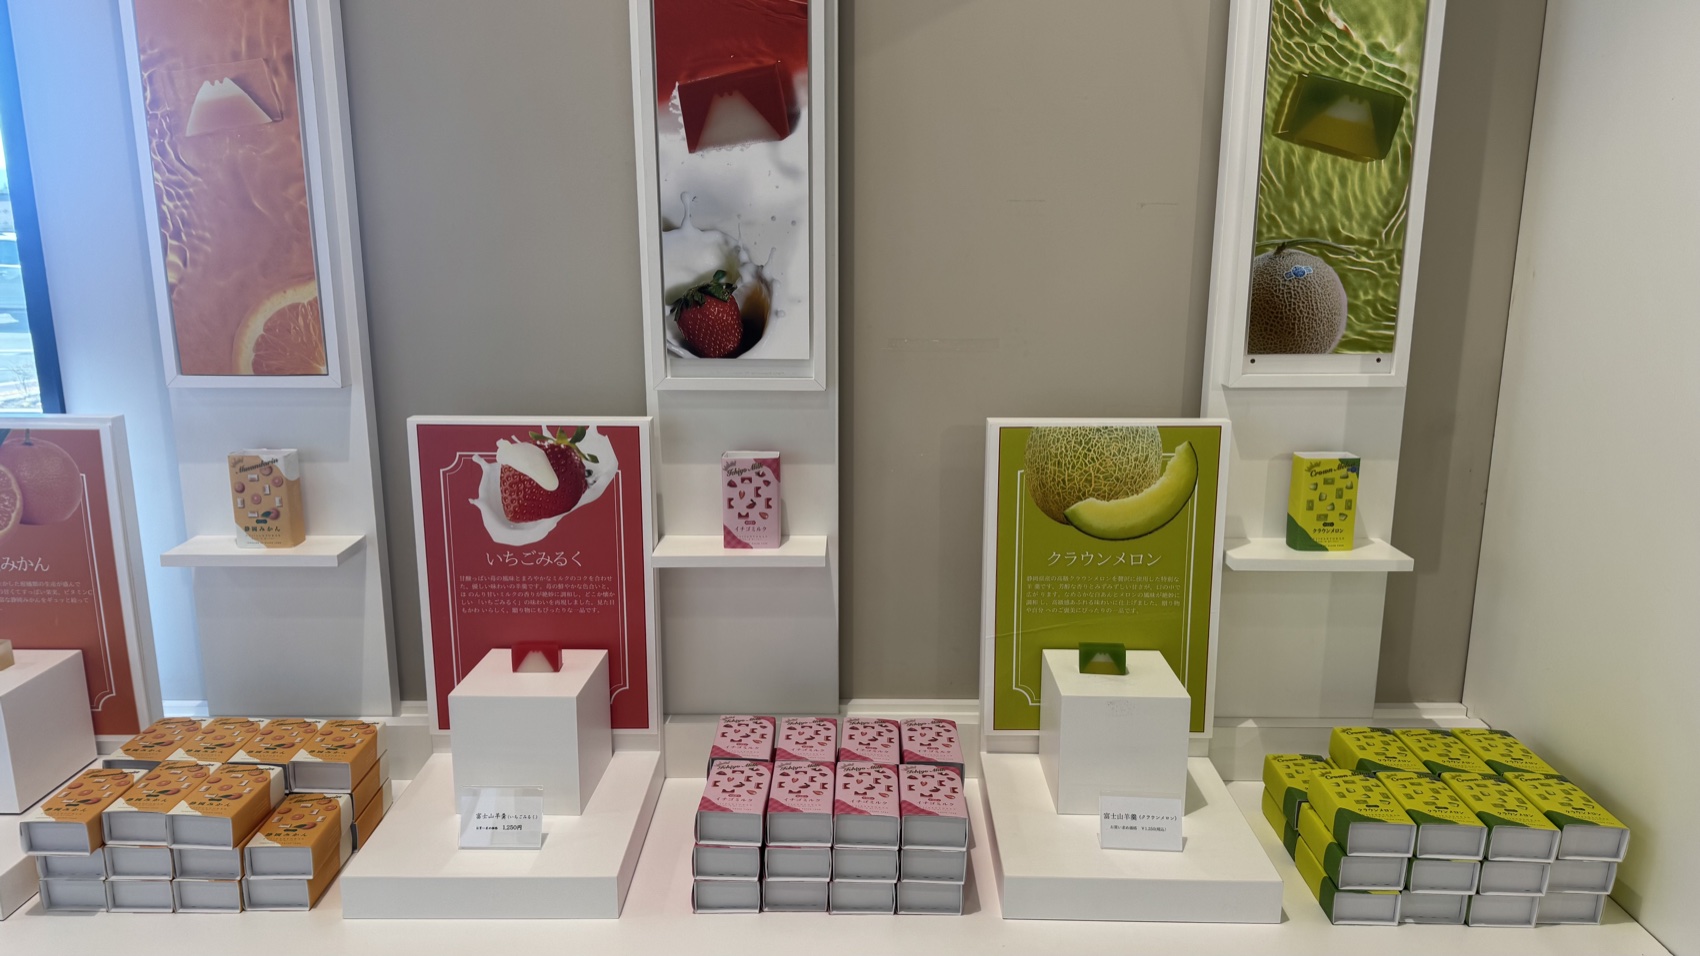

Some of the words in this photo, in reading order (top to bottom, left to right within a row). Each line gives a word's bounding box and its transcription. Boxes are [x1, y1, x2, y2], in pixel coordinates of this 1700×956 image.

[1310, 468, 1332, 478] Crown
[0, 556, 50, 572] みかん
[486, 550, 582, 567] いちごみるく
[1048, 551, 1162, 567] クラウンメロン
